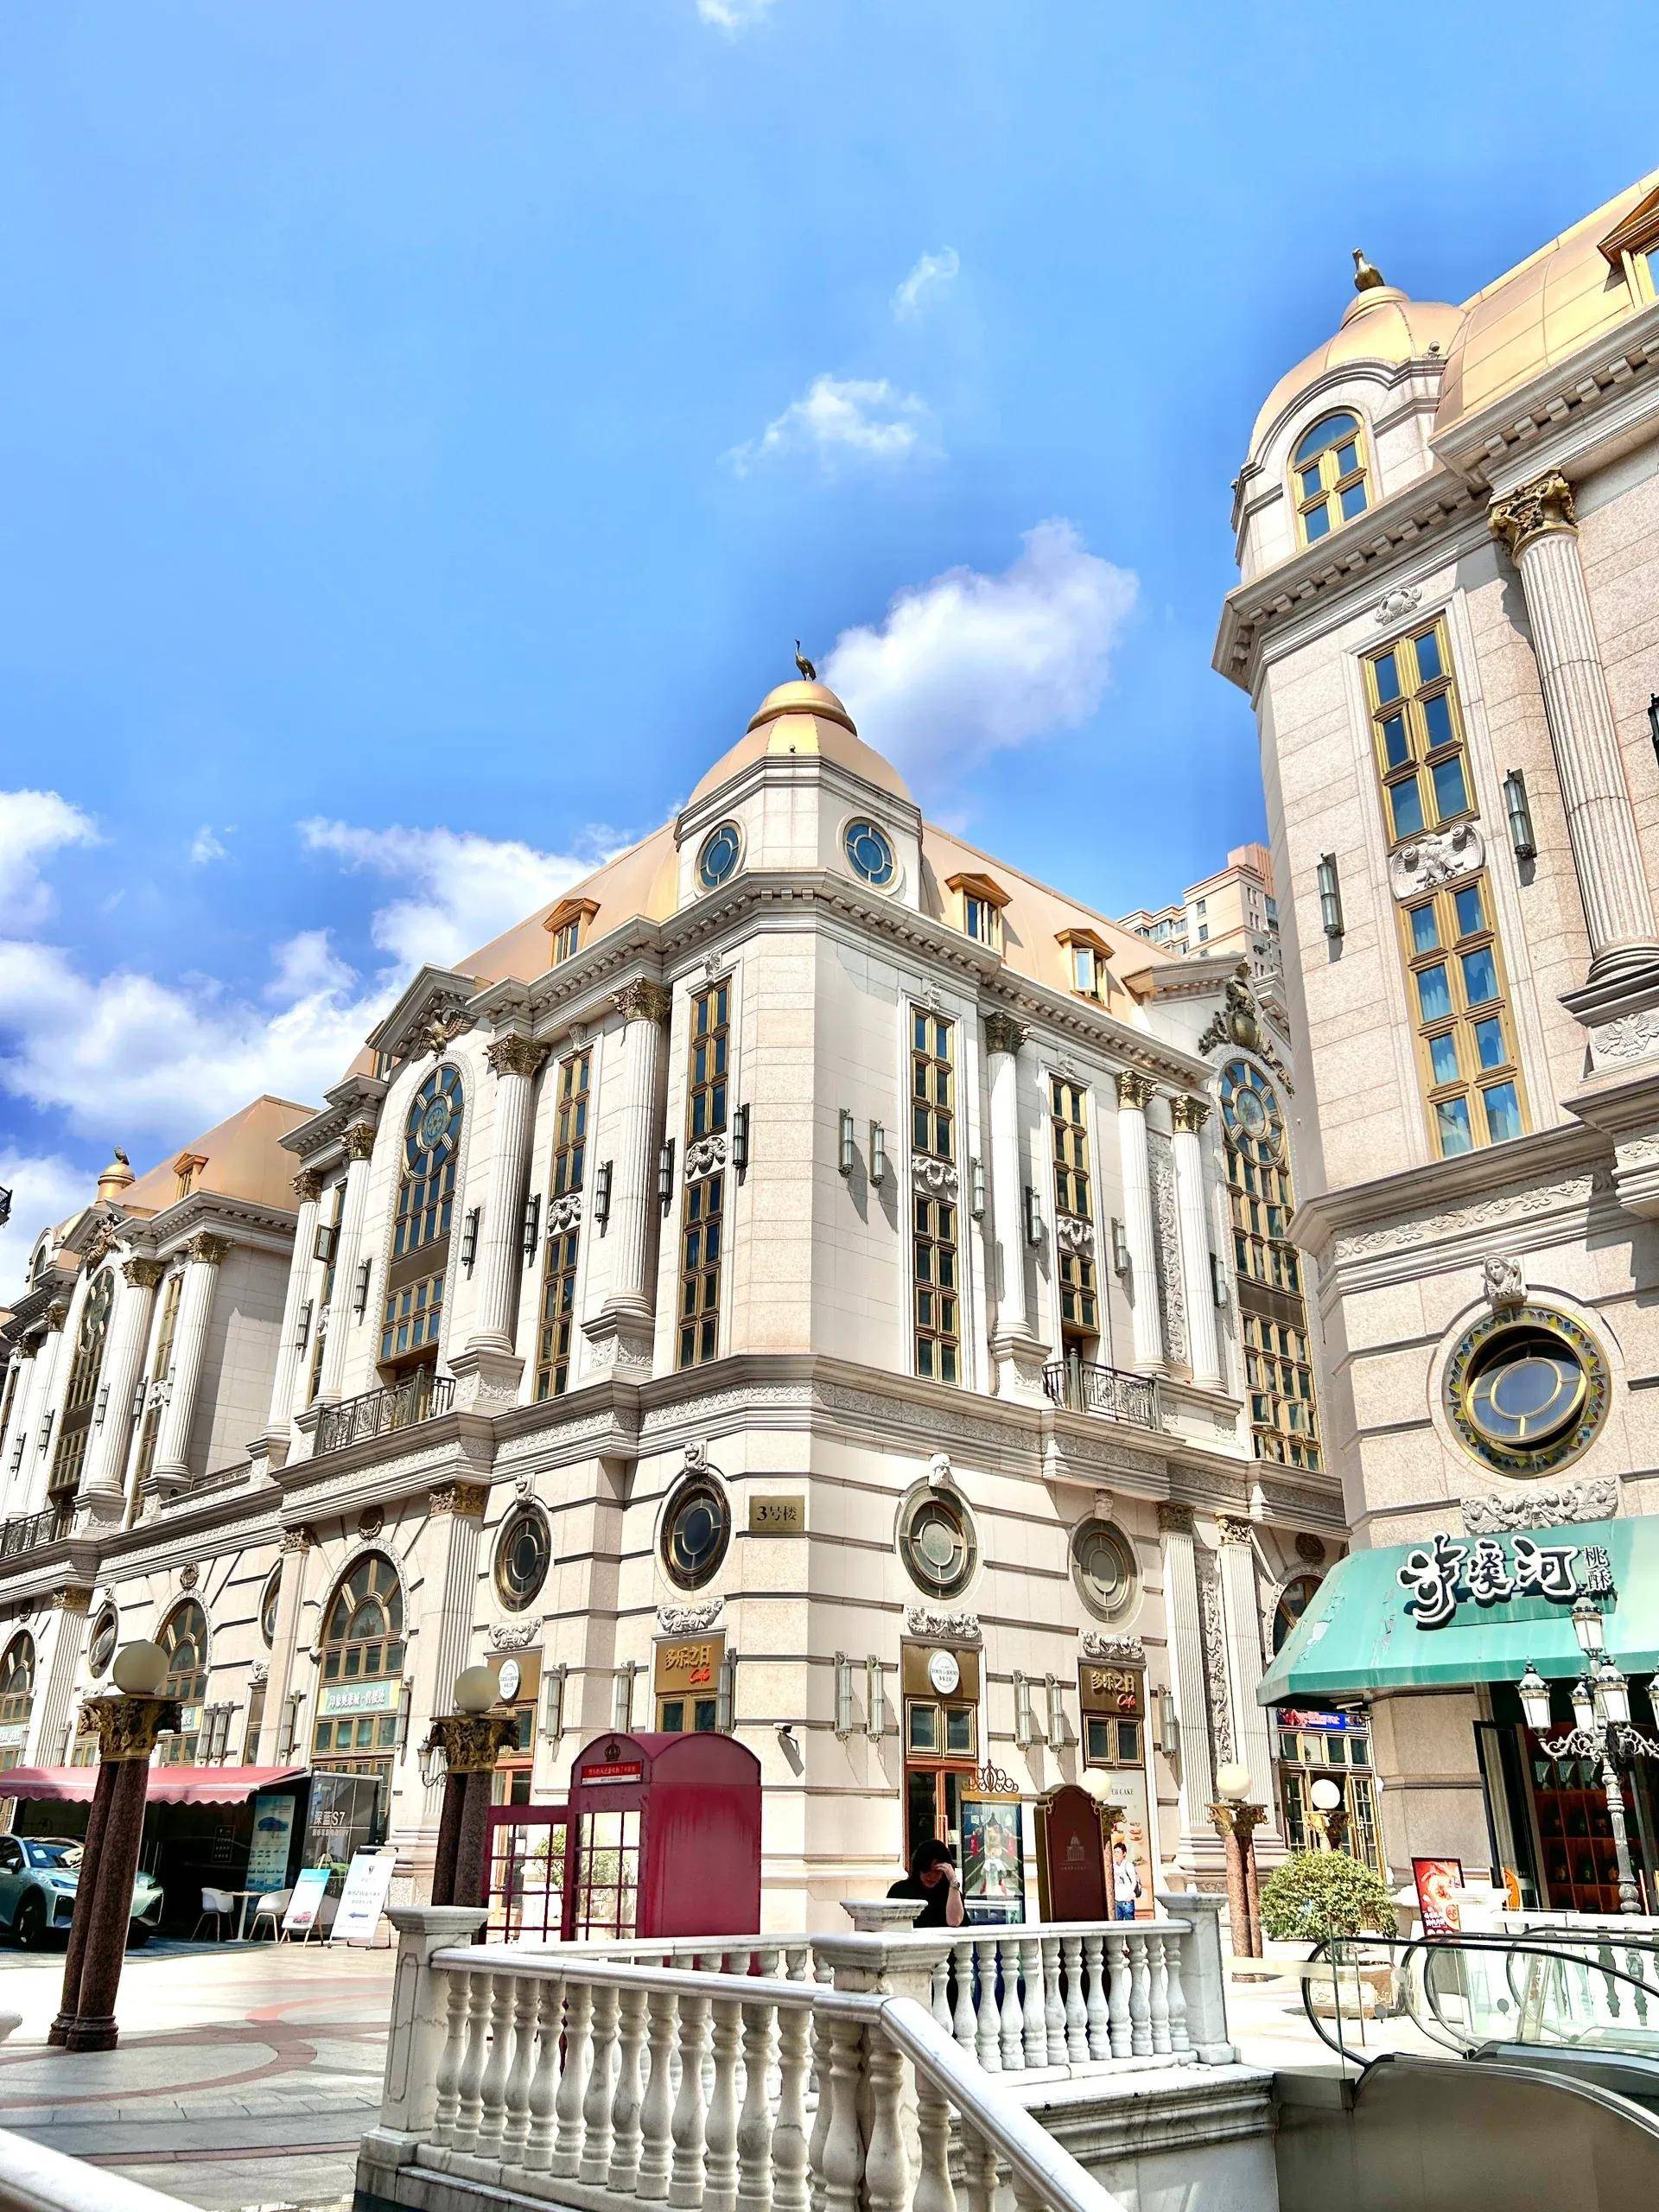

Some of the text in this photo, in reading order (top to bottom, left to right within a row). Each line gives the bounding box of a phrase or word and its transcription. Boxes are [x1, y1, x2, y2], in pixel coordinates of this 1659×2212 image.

[755, 1505, 797, 1522] 3号楼
[1582, 1544, 1612, 1592] 桃酥
[664, 1644, 712, 1671] 多乐之日
[1091, 1670, 1135, 1693] 多乐之日
